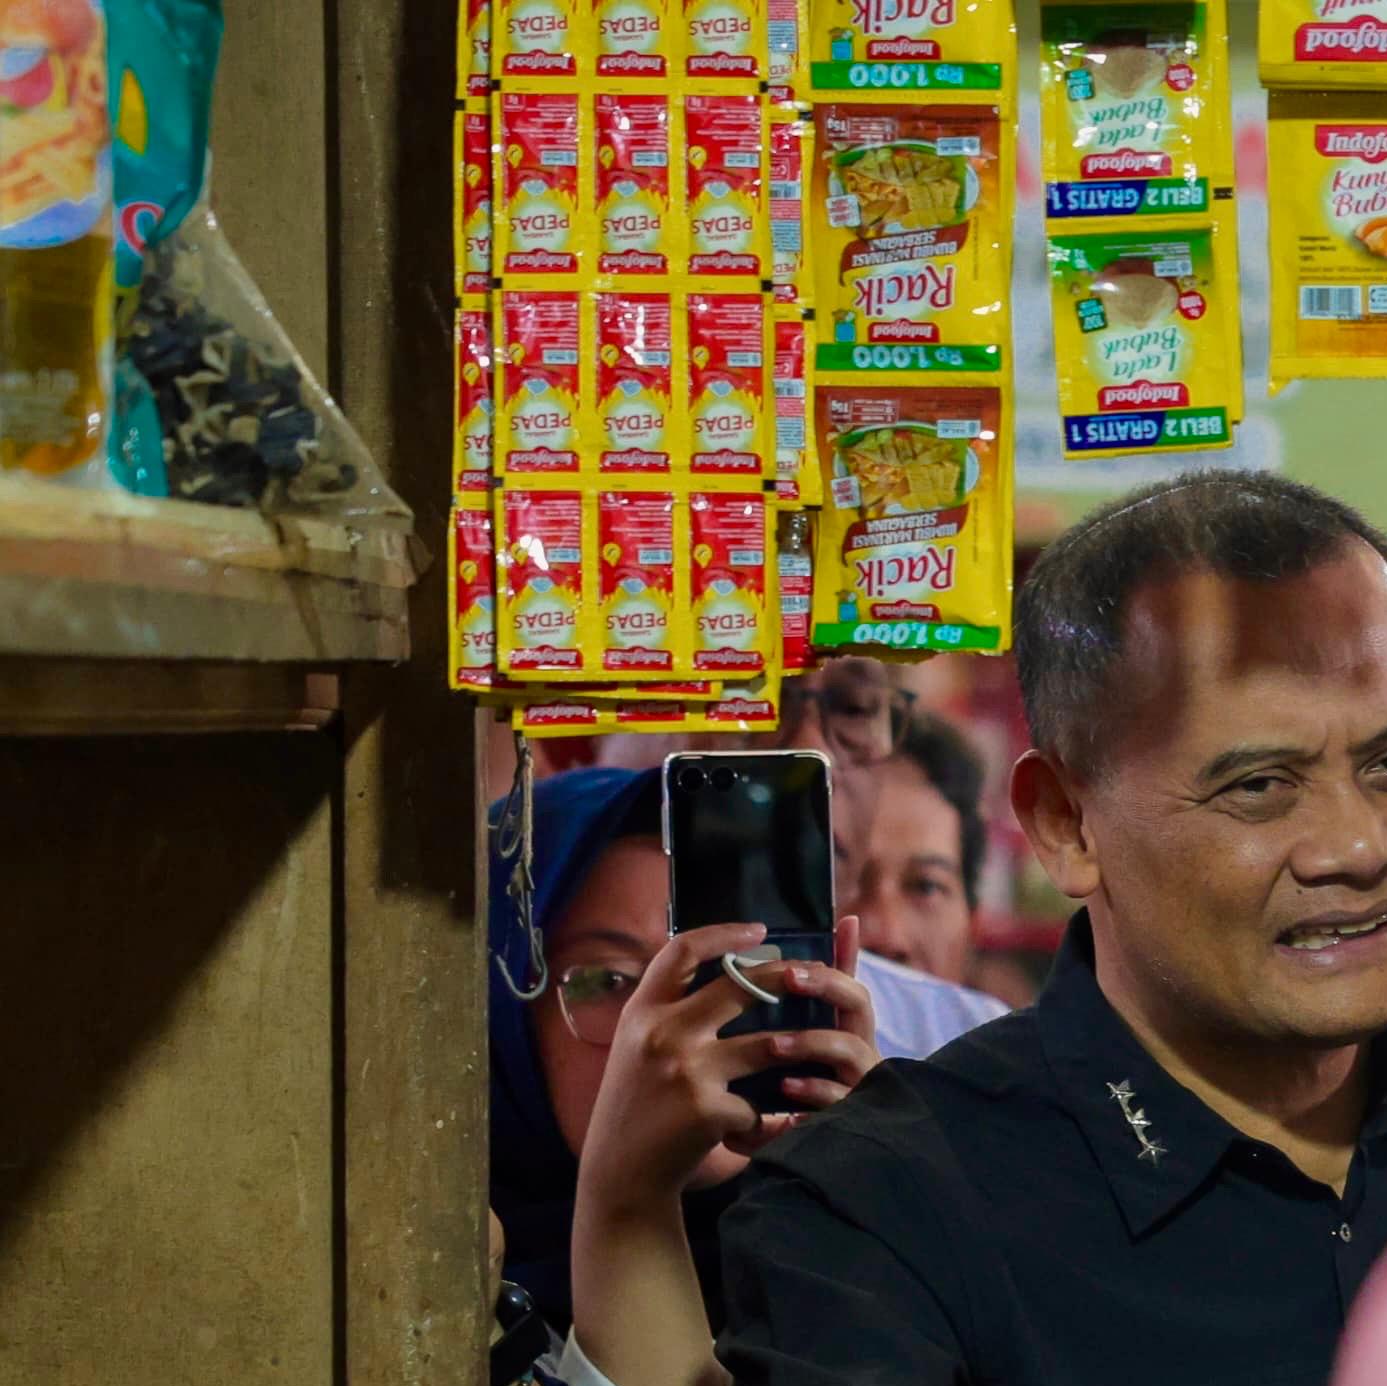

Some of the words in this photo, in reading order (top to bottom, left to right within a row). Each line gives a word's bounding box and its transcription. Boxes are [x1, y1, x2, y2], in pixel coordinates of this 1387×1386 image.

[508, 15, 568, 33] PEDAS
[600, 15, 660, 34] PEDAS
[689, 16, 751, 34] PEDAS
[851, 0, 955, 33] Racik
[872, 40, 934, 56] Indofood
[508, 56, 569, 71] Indofood
[604, 56, 661, 71] Indofood
[690, 56, 752, 71] Indofood
[848, 63, 929, 87] 1.000
[935, 64, 964, 84] Rp
[1086, 97, 1166, 125] Bubuk
[1053, 189, 1063, 210] 1
[1066, 189, 1139, 210] GRATIS
[1146, 188, 1159, 206] 2
[1161, 187, 1204, 206] BELI
[509, 214, 570, 233] PEDAS
[601, 215, 661, 233] PEDAS
[691, 216, 753, 234] PEDAS
[854, 265, 954, 315] Racik
[873, 322, 932, 338] Indofood
[1103, 327, 1181, 359] Bubuk
[852, 345, 929, 368] 1.000
[935, 348, 963, 366] Rp
[1112, 351, 1177, 379] Lada
[1104, 384, 1180, 405] Indofood
[511, 412, 571, 431] PEDAS
[603, 414, 664, 432] PEDAS
[693, 415, 754, 433] PEDAS
[1165, 419, 1177, 436] 2
[1180, 416, 1223, 435] BELI
[1071, 424, 1082, 442] 1
[1085, 420, 1158, 442] GRATIS
[914, 522, 958, 538] BUMBU
[855, 547, 955, 597] Racik
[514, 611, 575, 629] PEDAS
[606, 612, 667, 630] PEDAS
[696, 614, 757, 630] PEDAS
[853, 623, 928, 644] 1.000
[935, 624, 963, 641] Rp
